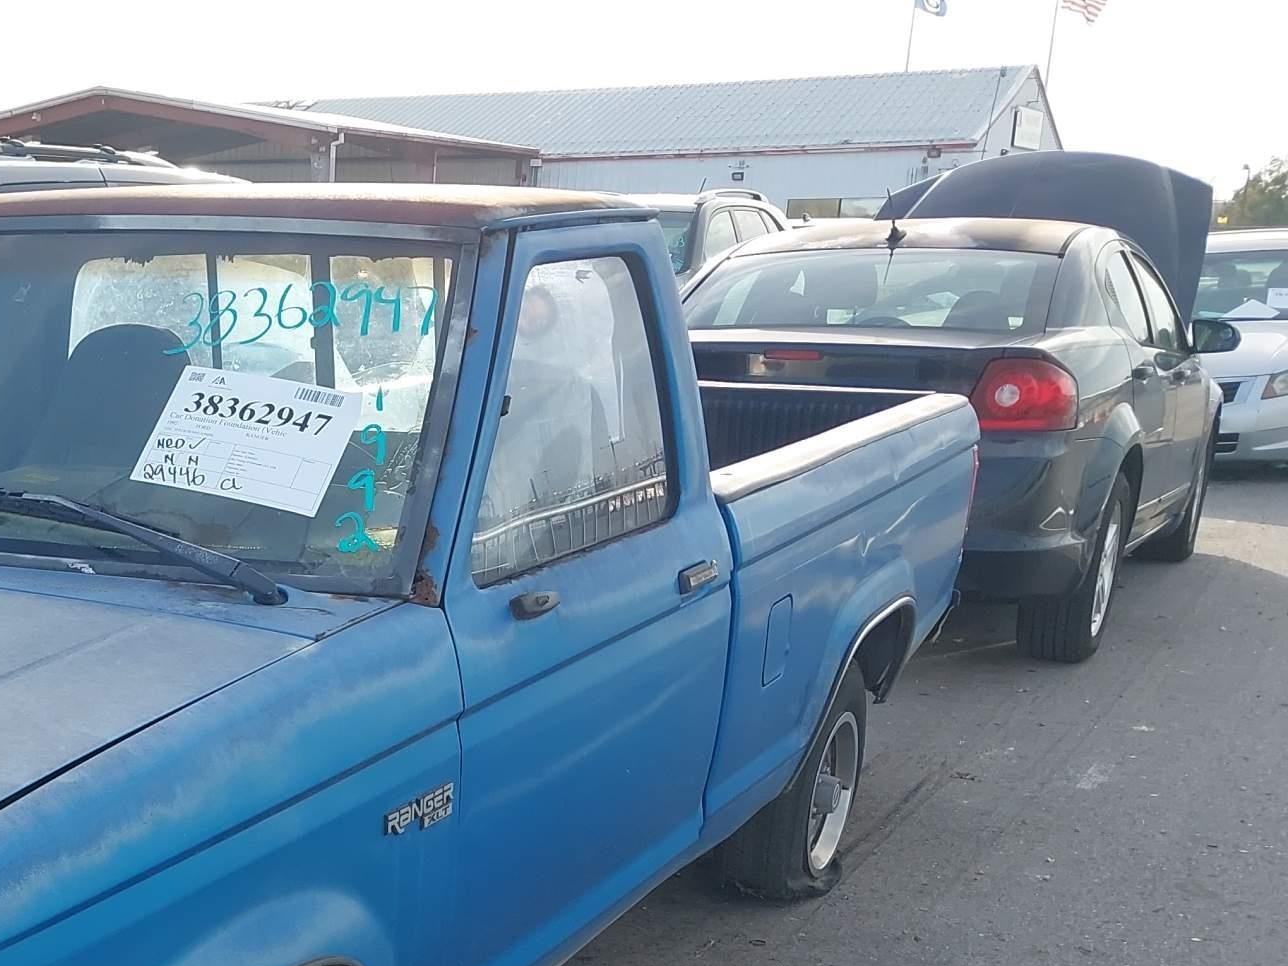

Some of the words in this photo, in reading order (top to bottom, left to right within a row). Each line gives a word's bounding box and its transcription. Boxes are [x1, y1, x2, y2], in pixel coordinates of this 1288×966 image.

[163, 281, 438, 356] 38362947
[184, 391, 333, 437] 38362947
[184, 414, 218, 426] Donation
[219, 418, 261, 432] Foundation
[143, 463, 205, 487] 29446
[385, 781, 455, 835] RANGER
